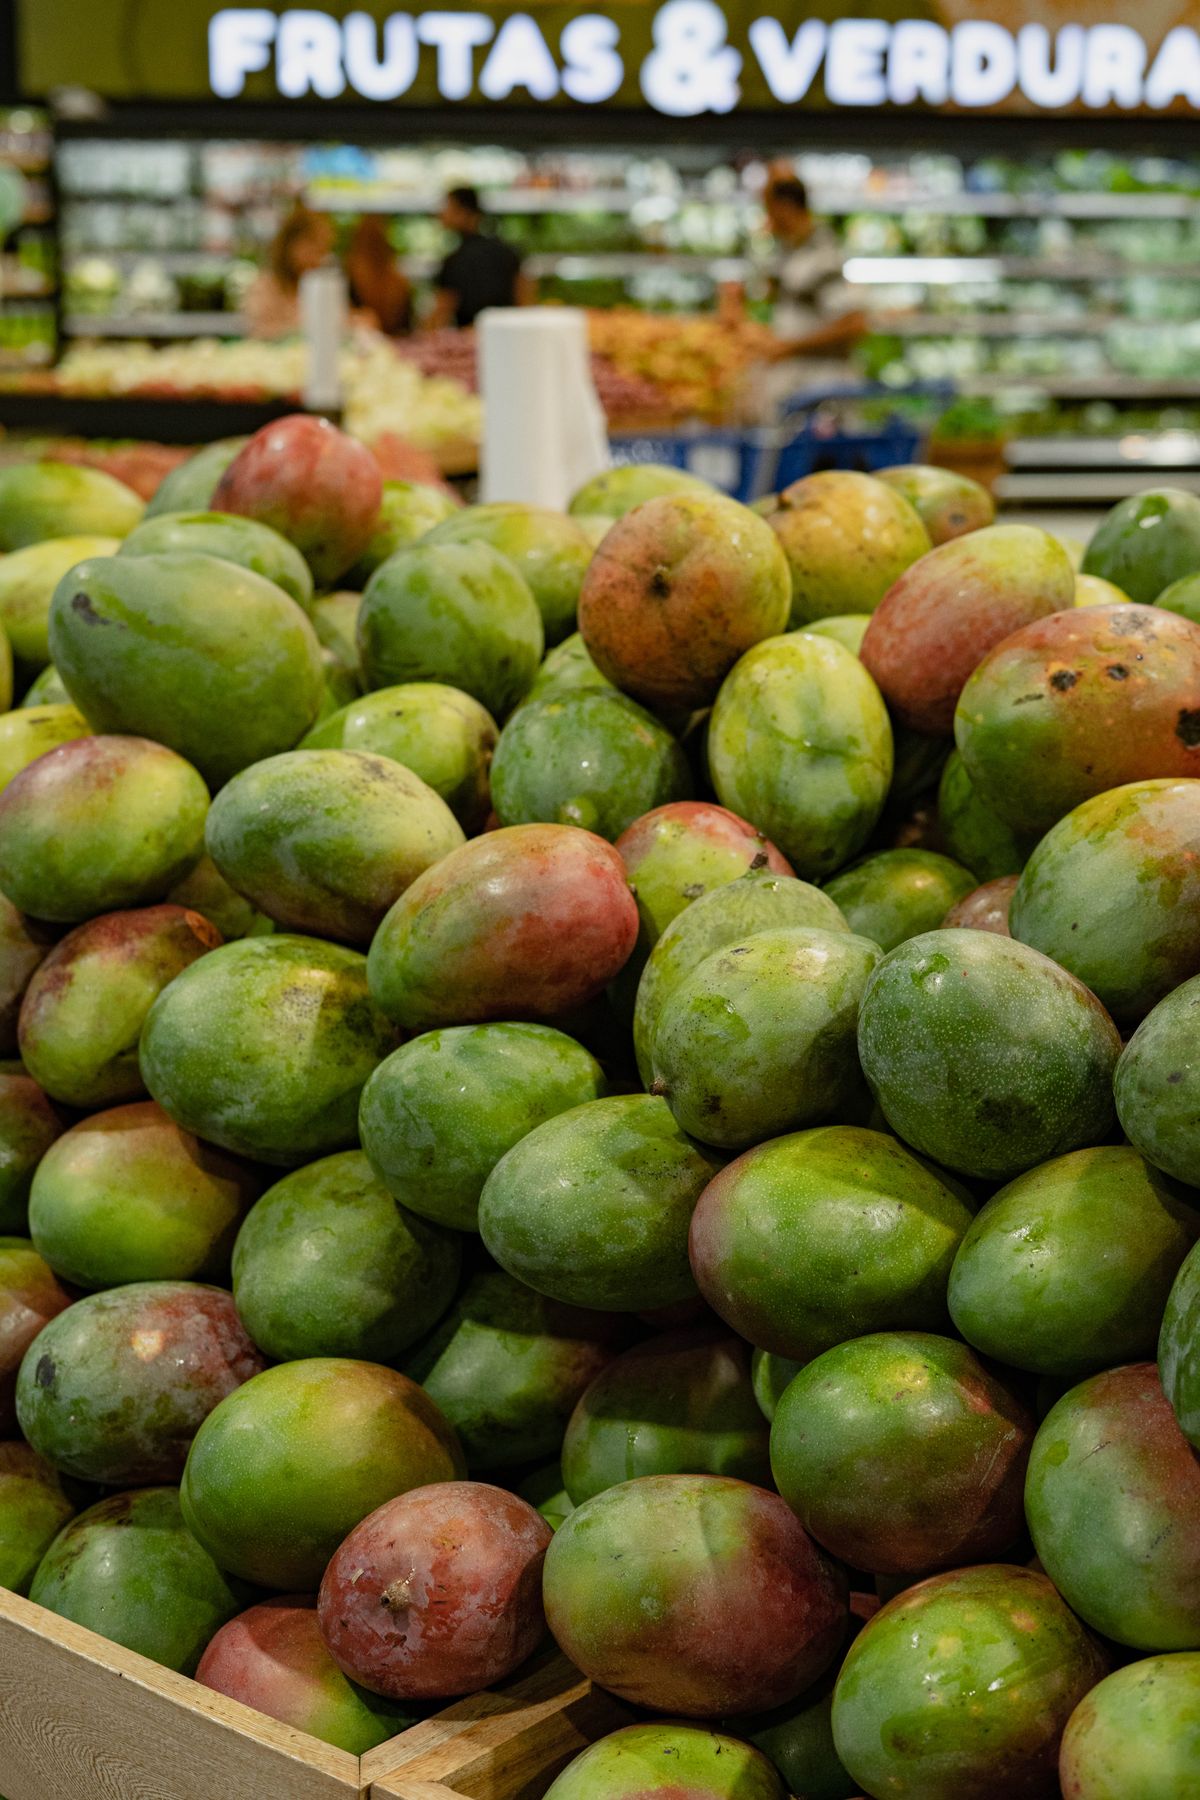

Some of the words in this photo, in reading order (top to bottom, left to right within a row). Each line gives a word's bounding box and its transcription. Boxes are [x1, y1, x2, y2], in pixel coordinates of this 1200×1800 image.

[209, 10, 624, 102] FRUTAS
[642, 0, 741, 115] &
[749, 18, 1200, 108] VERDURA
